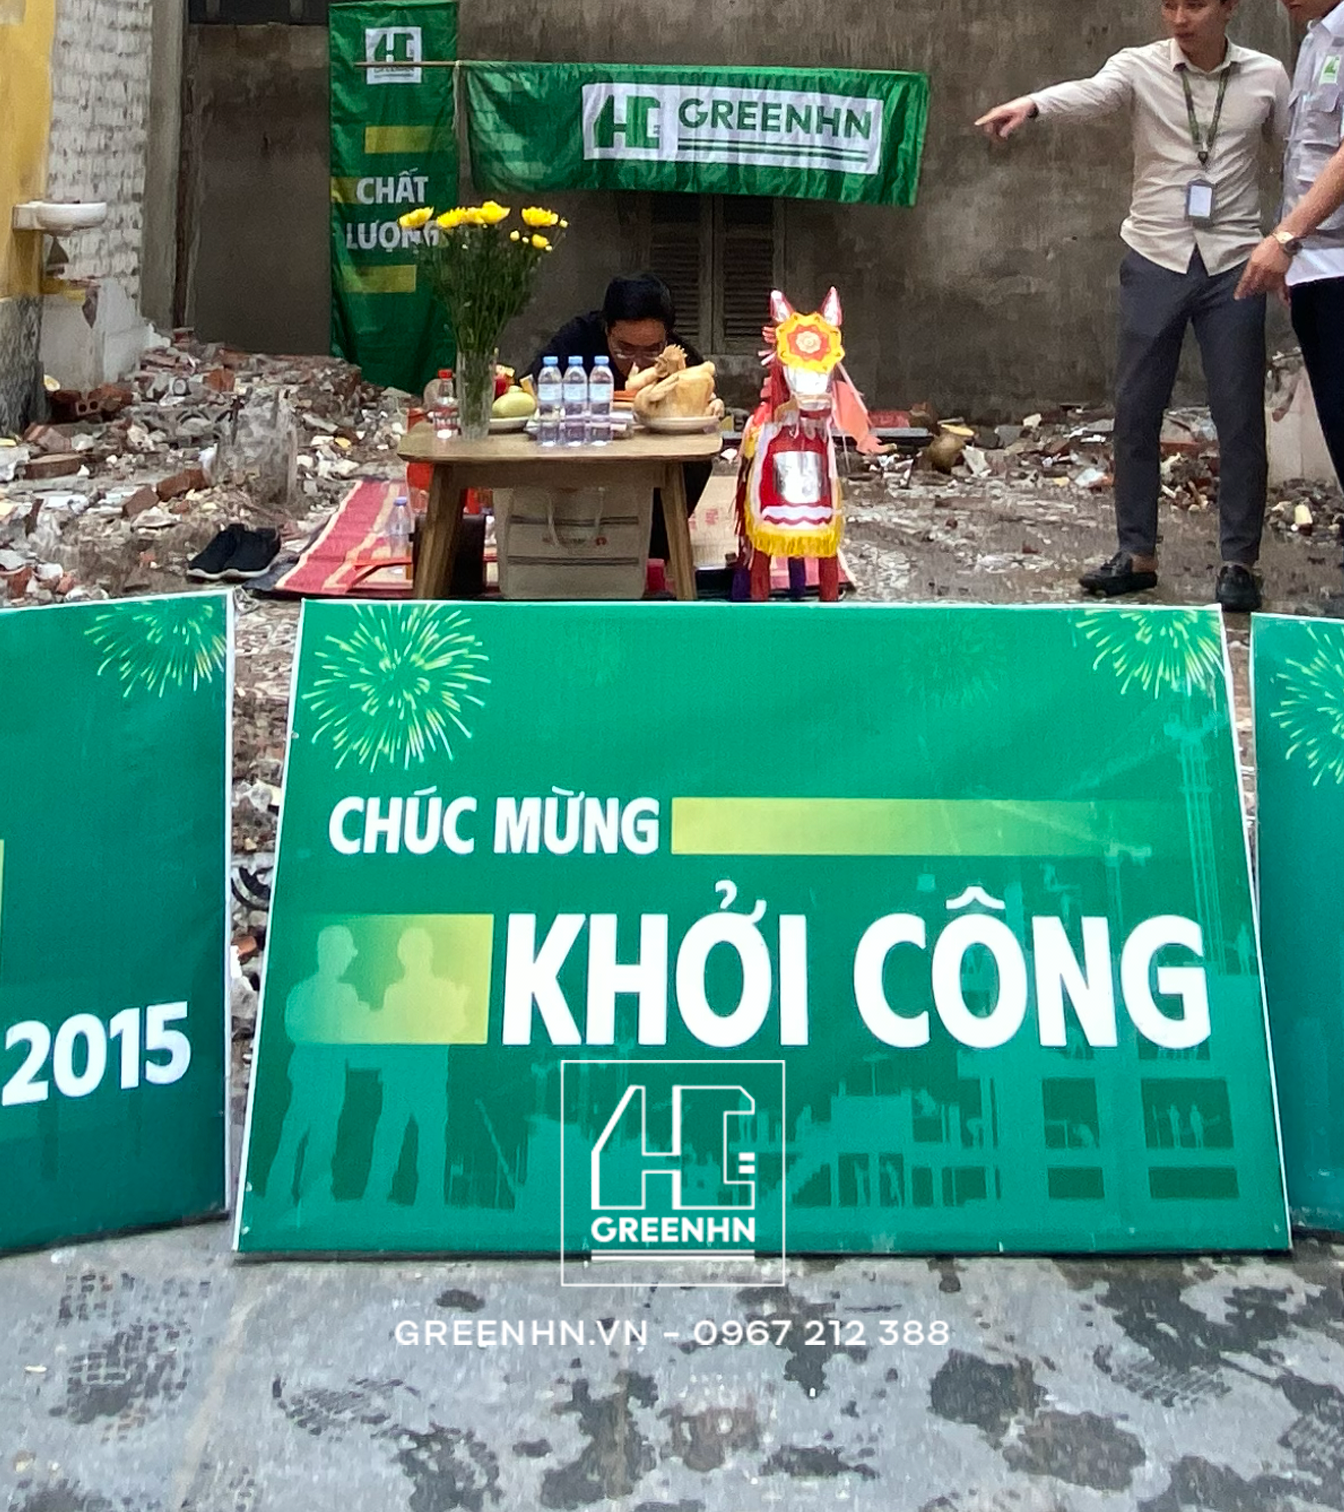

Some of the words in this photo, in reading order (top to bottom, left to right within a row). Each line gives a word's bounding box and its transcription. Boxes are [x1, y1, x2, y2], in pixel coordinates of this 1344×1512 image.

[678, 98, 872, 139] GREENHN
[356, 167, 429, 205] CHẤT
[346, 219, 440, 253] LƯỢNG
[328, 785, 477, 855] CHÚC
[493, 785, 660, 855] MỪNG
[502, 880, 808, 1048] KHỞI
[853, 885, 1212, 1049] CÔNG
[1, 1000, 192, 1108] 2015
